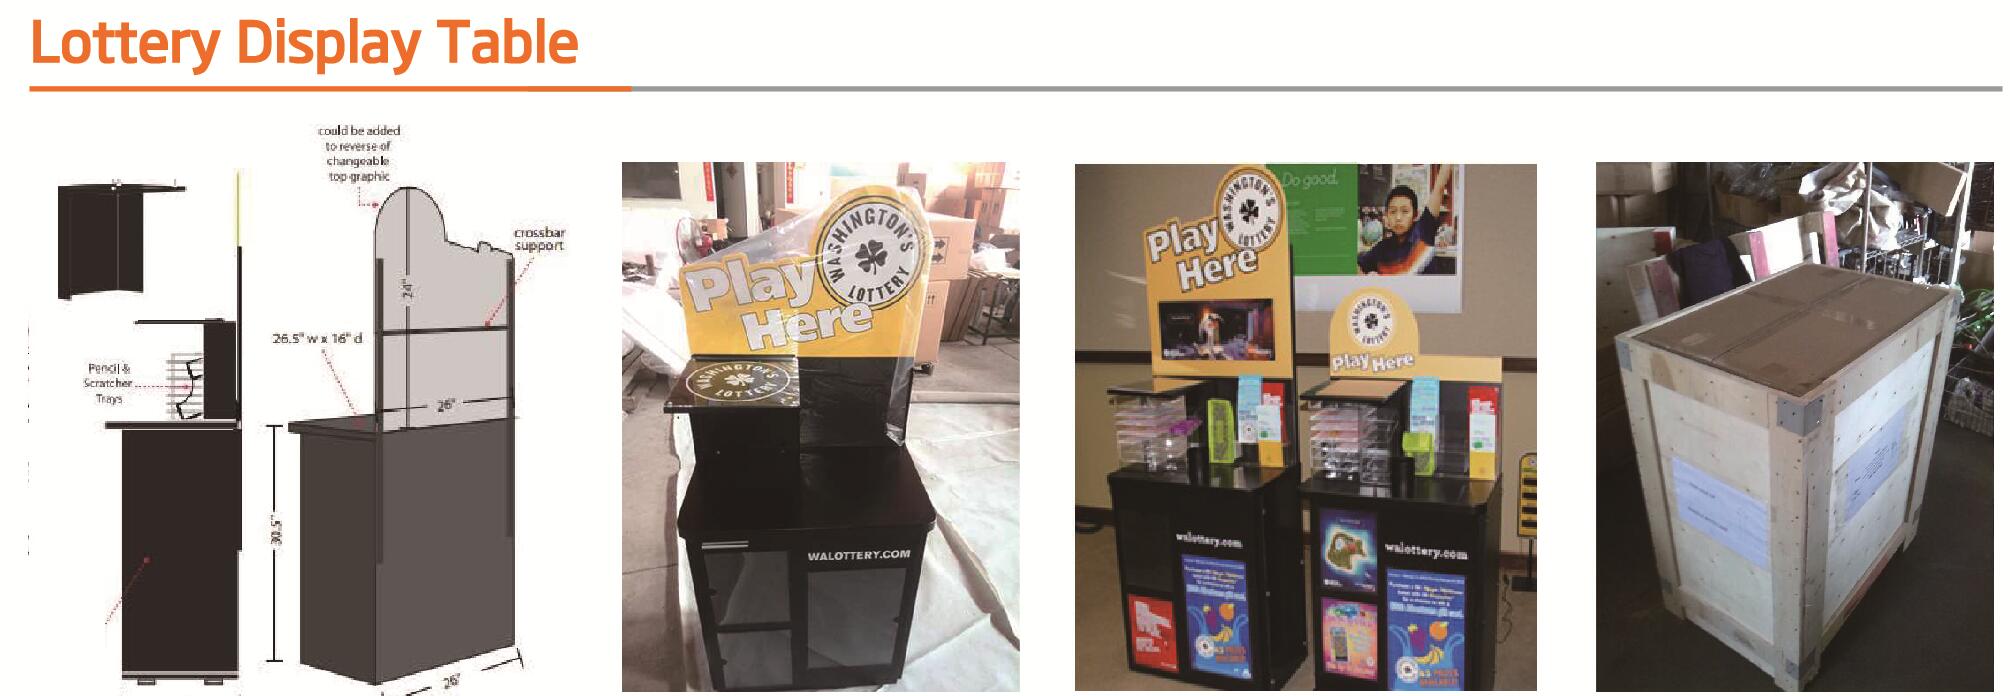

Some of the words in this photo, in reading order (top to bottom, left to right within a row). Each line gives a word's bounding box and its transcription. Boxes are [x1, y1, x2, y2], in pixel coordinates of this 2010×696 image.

[1282, 172, 1301, 187] Do
[828, 207, 914, 284] WASHINGTON'S
[1146, 218, 1219, 264] Play
[685, 258, 818, 312] Play
[848, 267, 911, 303] LOTTERY
[1176, 248, 1259, 293] Here
[740, 302, 874, 351] Here
[1332, 353, 1370, 371] Play
[1372, 352, 1415, 372] Here
[807, 549, 912, 562] WALOTTERY.COM
[1175, 531, 1244, 550] walottery.com
[1384, 541, 1469, 561] walottery.com
